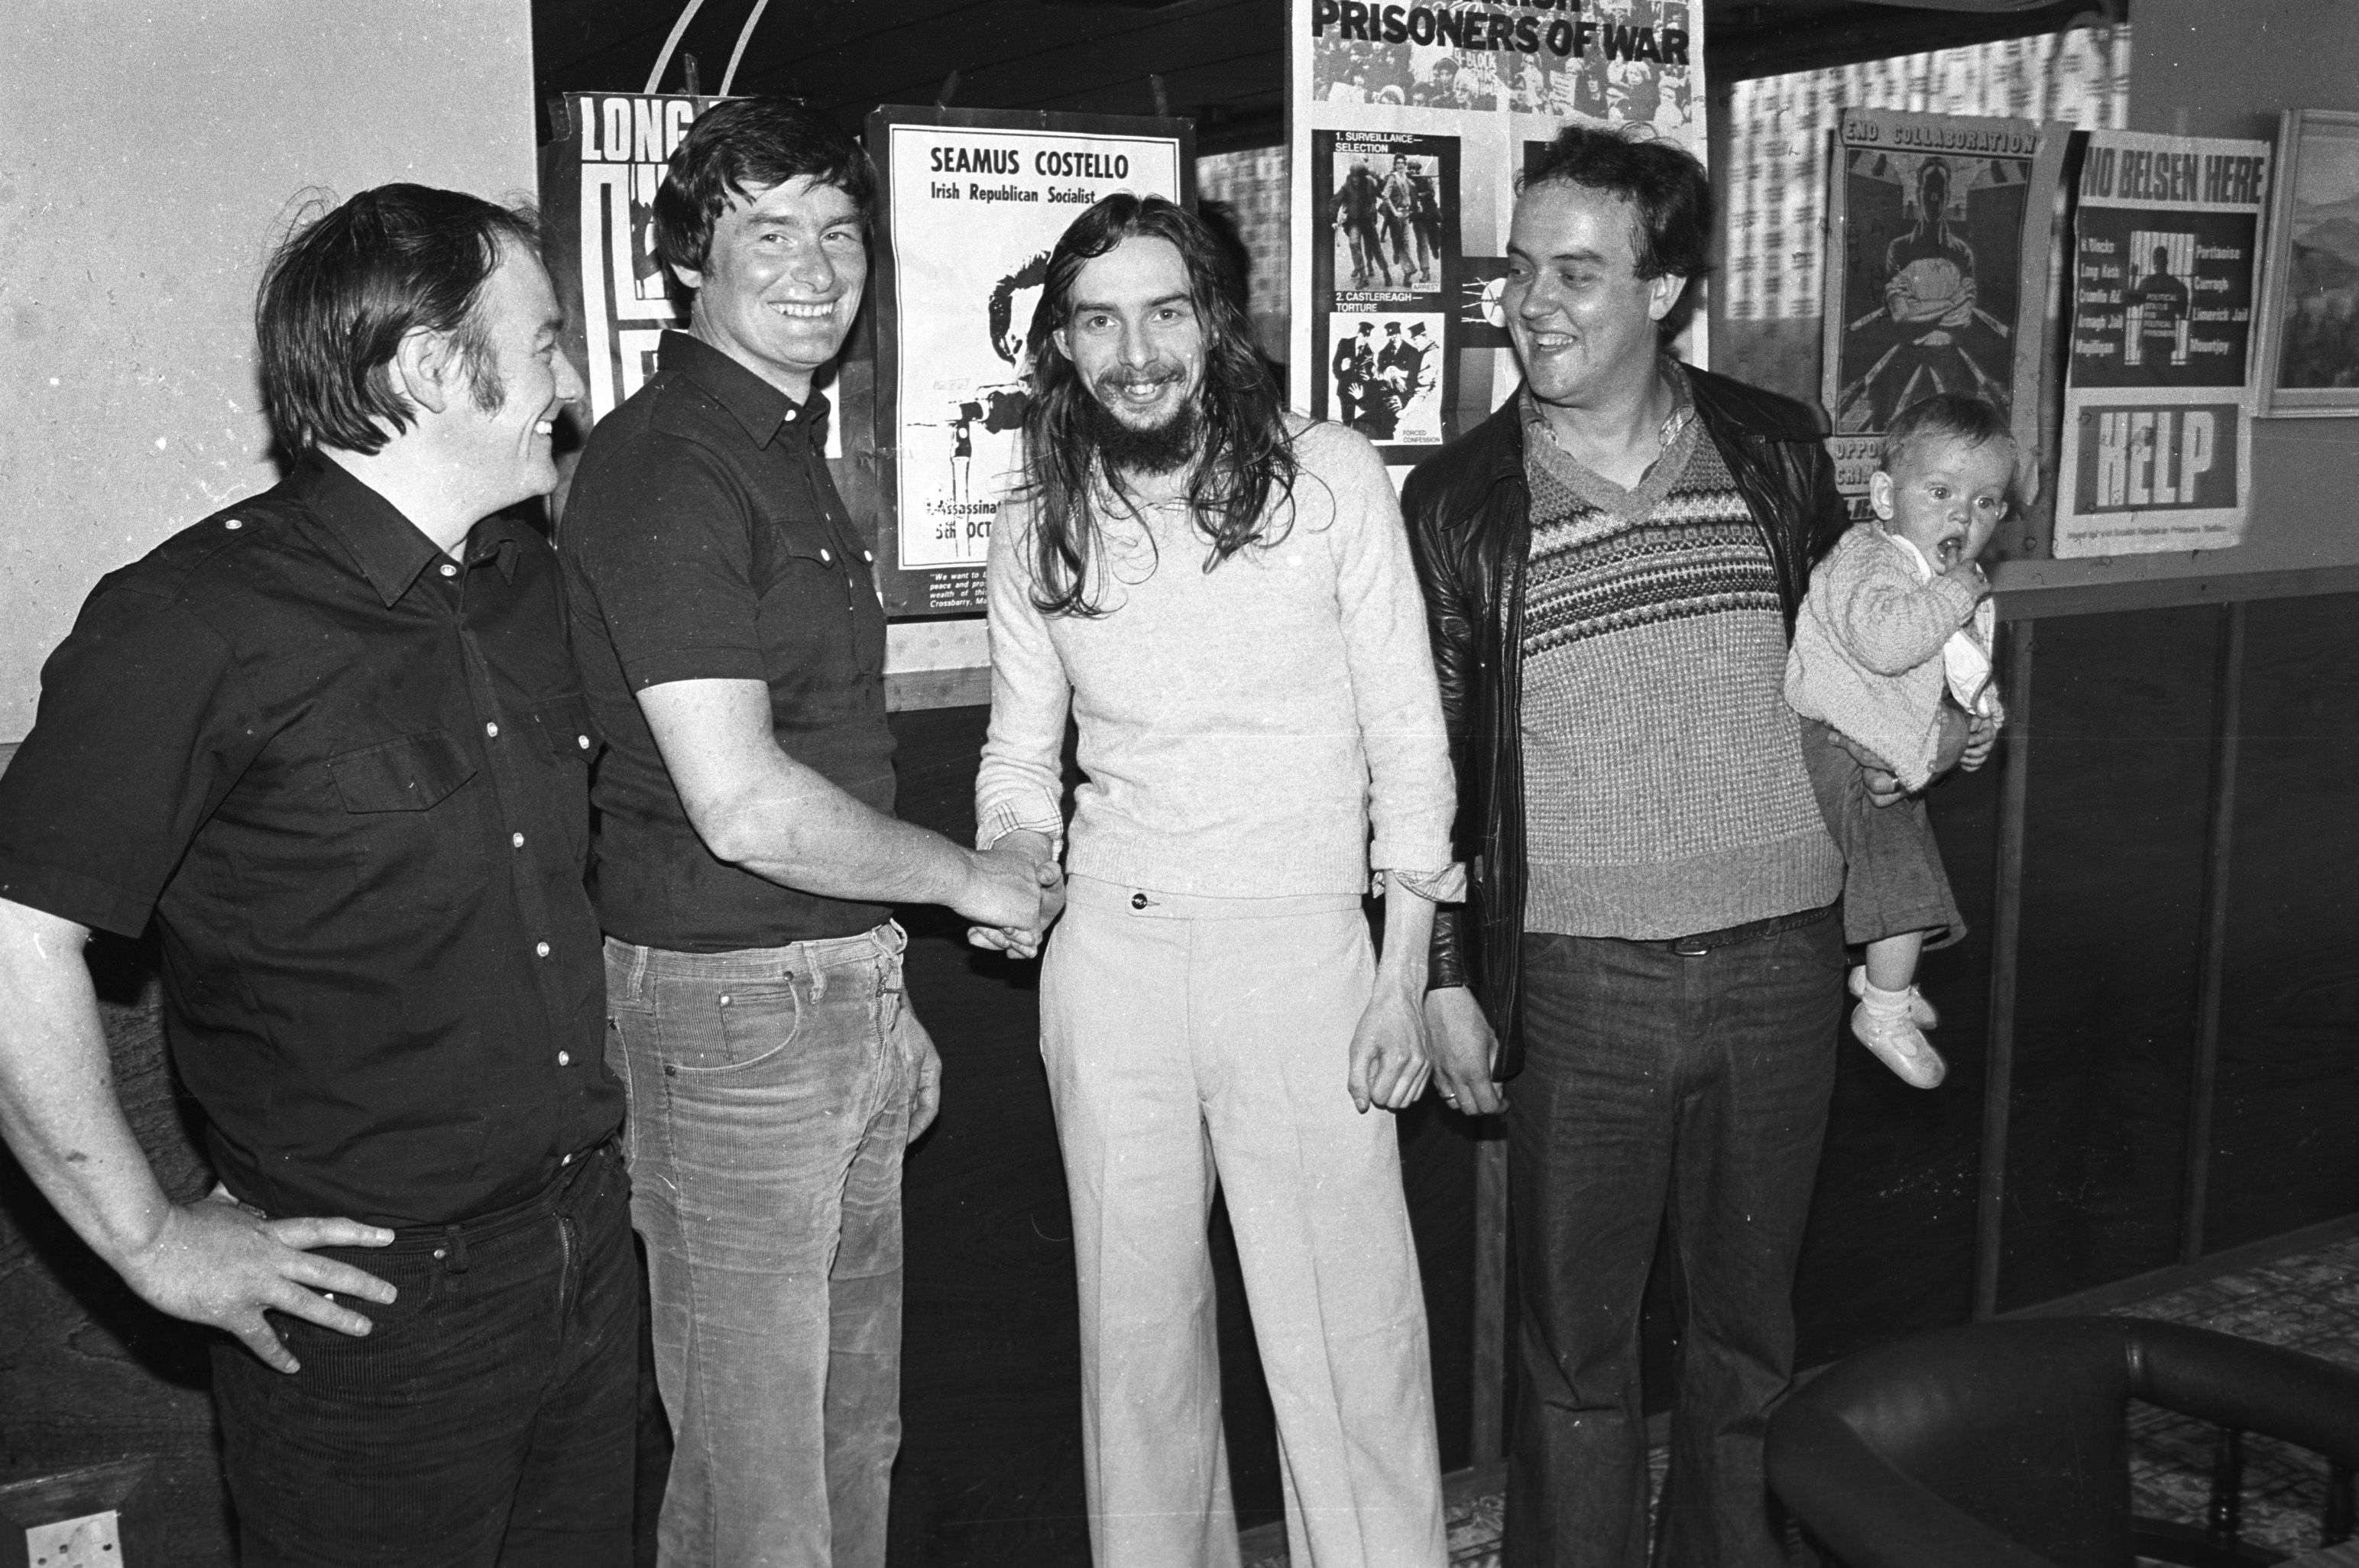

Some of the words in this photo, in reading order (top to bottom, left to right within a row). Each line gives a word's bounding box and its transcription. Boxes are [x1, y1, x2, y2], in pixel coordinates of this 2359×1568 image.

[1311, 0, 1540, 53] PRISONERS
[1545, 18, 1597, 58] OF
[1602, 23, 1690, 65] WAR
[580, 97, 694, 162] LONG
[1335, 131, 1343, 141] 1.
[1845, 120, 1878, 141] END
[1894, 122, 2038, 154] COLLABORATION
[1335, 142, 1389, 153] SELECTION
[930, 147, 1020, 175] SEAMUS
[1035, 151, 1129, 180] COSTELLO
[2081, 146, 2115, 198] NO
[2117, 149, 2199, 202] BELSEN
[2204, 154, 2265, 205] HERE
[930, 181, 960, 200] Irish
[969, 183, 1039, 204] Republican
[1047, 186, 1097, 205] Socialist
[1336, 292, 1344, 302] 2.
[1336, 303, 1378, 313] TORTURE
[1834, 442, 1880, 460] OPPO
[2096, 410, 2215, 507] HELP
[929, 583, 951, 591] peace
[930, 598, 973, 608] Crossbarry,
